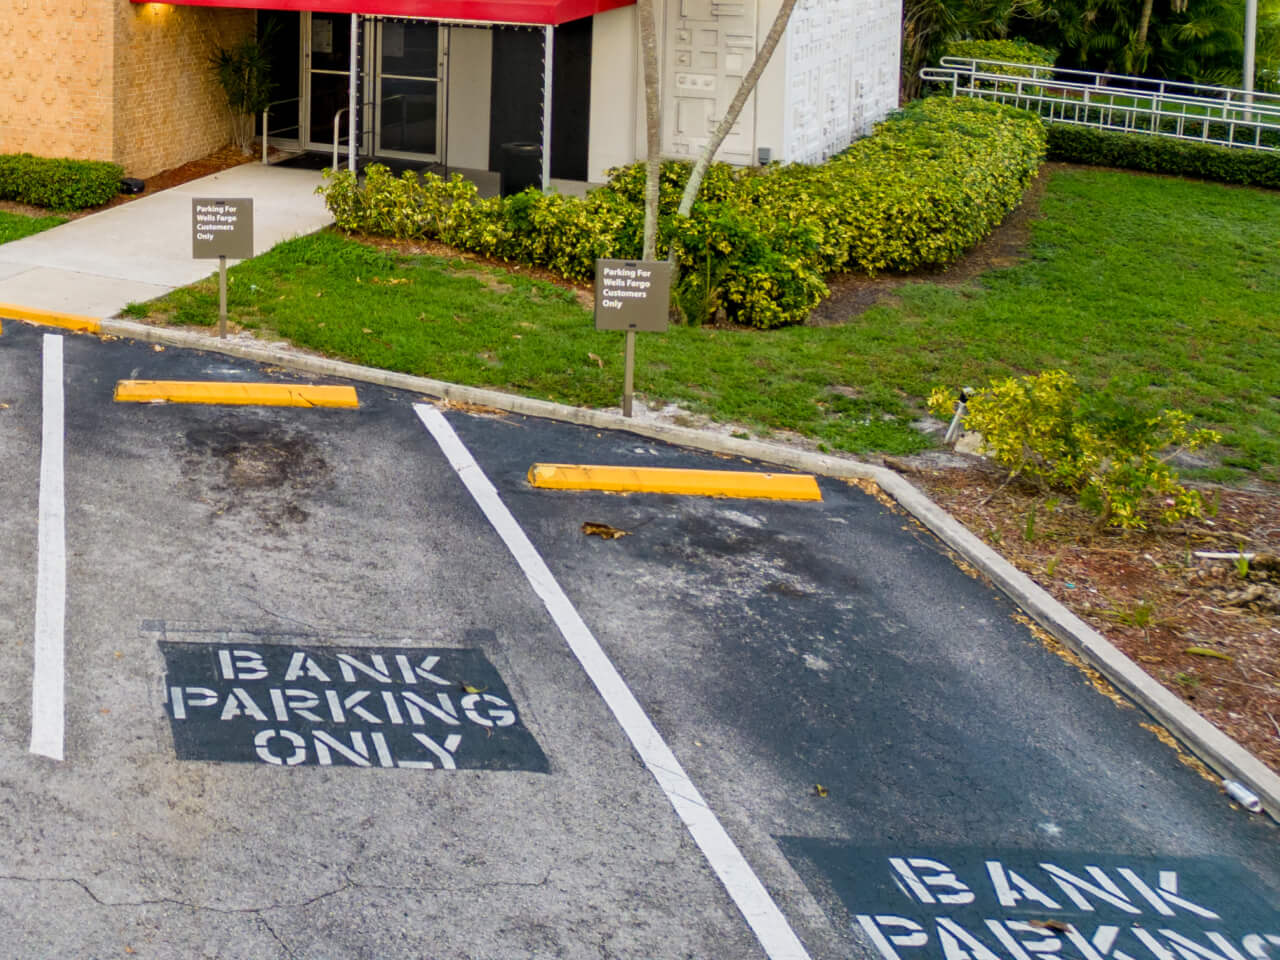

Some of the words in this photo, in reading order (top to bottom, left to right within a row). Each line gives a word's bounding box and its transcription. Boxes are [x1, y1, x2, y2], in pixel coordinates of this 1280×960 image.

[196, 205, 224, 214] Parking
[225, 205, 237, 213] For
[216, 214, 238, 223] Fargo
[196, 223, 234, 231] Customers
[196, 232, 214, 241] Only
[603, 267, 636, 279] Parking
[637, 269, 652, 278] For
[603, 278, 625, 287] Wells
[626, 279, 651, 289] Fargo
[602, 289, 647, 298] Customers
[602, 299, 623, 310] Only
[218, 649, 452, 686] BANK
[169, 685, 517, 728] PARKING
[254, 728, 463, 770] ONLY
[887, 857, 1222, 919] BANK
